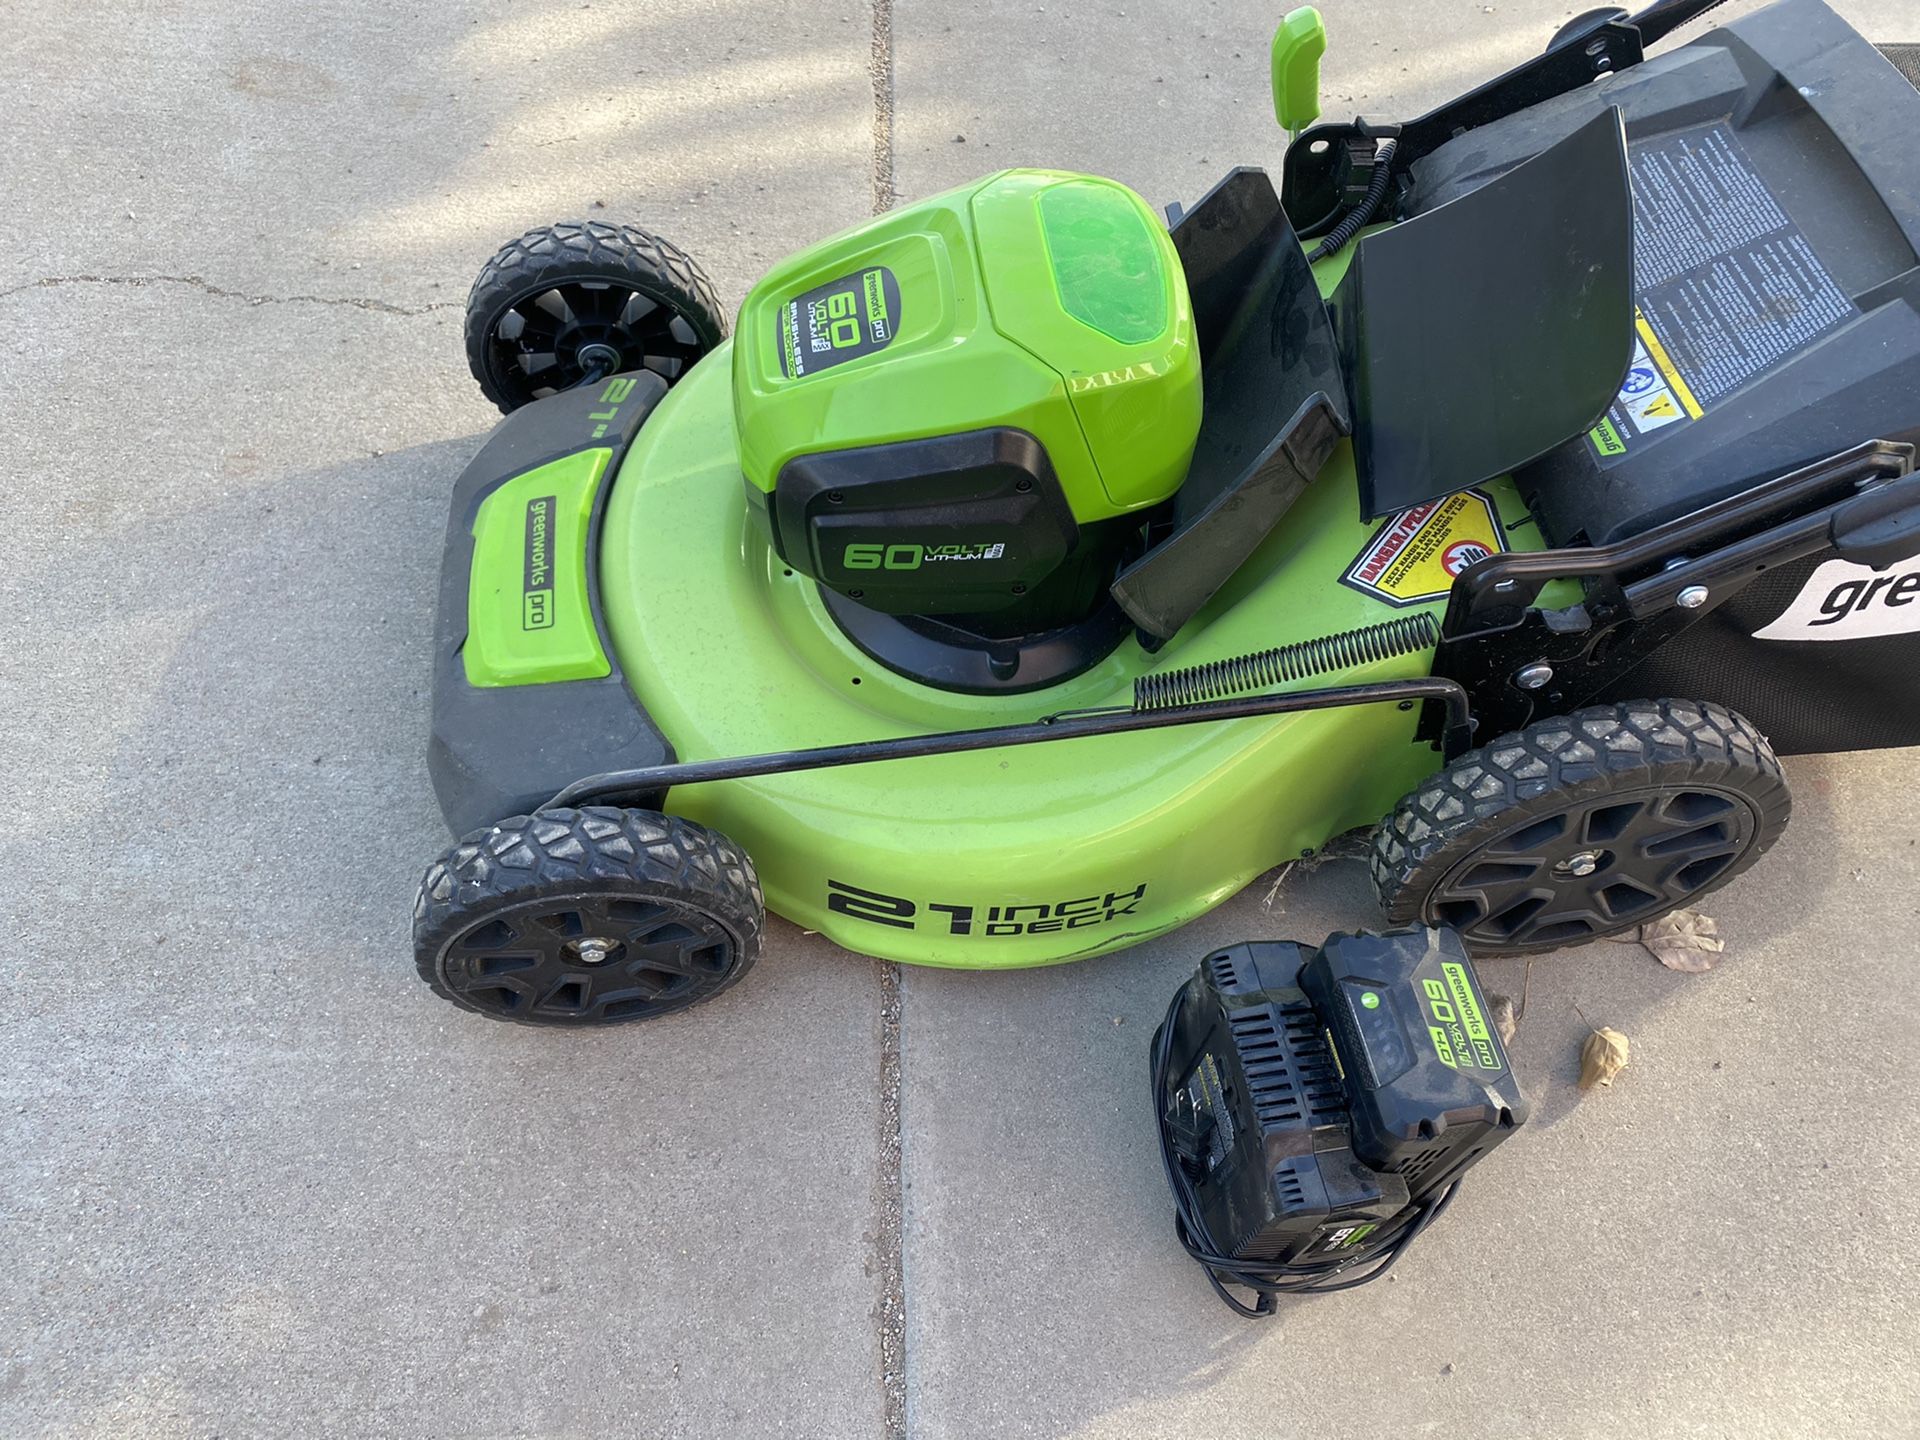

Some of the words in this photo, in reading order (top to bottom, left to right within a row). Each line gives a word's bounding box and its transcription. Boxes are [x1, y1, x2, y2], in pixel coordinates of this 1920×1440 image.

[865, 272, 882, 318] greenworks
[790, 301, 805, 376] BRUSHLESS
[807, 301, 819, 339] LITHIUM
[815, 298, 830, 340] VOLT
[827, 291, 862, 349] 60
[871, 319, 886, 339] pro
[530, 501, 549, 586] greenworks
[1384, 566, 1401, 585] KEEP
[1399, 543, 1420, 567] HANDS
[1418, 529, 1432, 545] AND
[1429, 513, 1446, 530] FEET
[1443, 496, 1461, 515] AWAY
[1420, 538, 1435, 551] LAS
[1432, 516, 1454, 539] MANOS
[1455, 498, 1469, 512] LOS
[843, 543, 924, 570] 60
[925, 543, 991, 555] VOLT
[924, 553, 982, 562] LITHIUM
[1420, 548, 1436, 563] PIES
[528, 594, 545, 624] pro
[828, 879, 973, 936] 21
[1422, 979, 1457, 1022] 60
[1445, 966, 1482, 1035] greenworks
[1474, 1041, 1493, 1066] pro
[1436, 1031, 1453, 1063] 4.0
